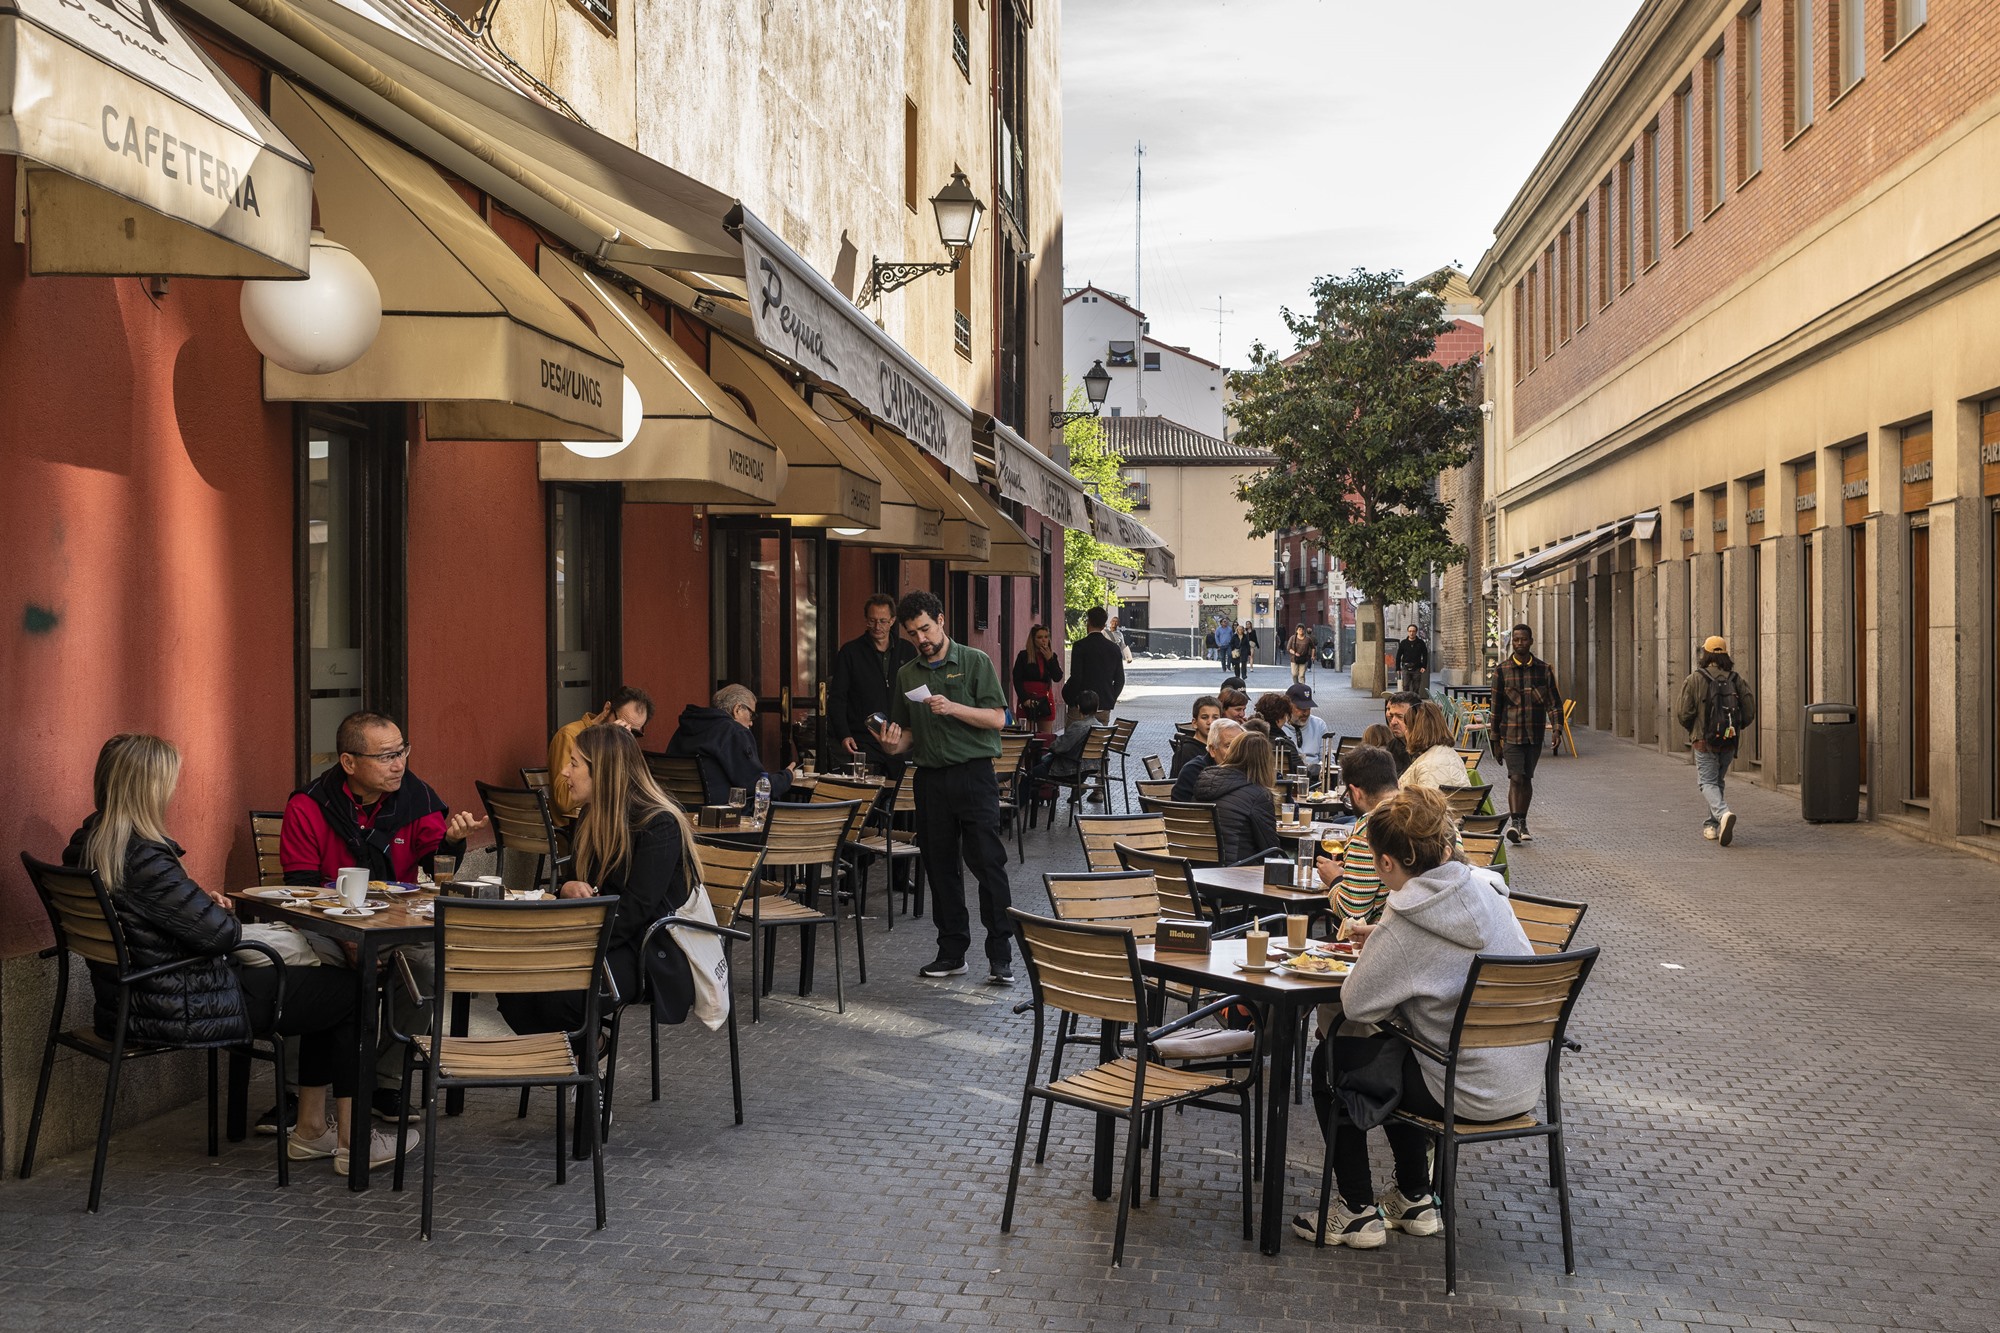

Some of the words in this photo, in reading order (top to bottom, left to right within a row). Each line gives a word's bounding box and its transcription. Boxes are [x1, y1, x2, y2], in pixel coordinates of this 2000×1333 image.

[101, 104, 261, 218] CAFETERIA
[540, 358, 603, 409] DESAYUNOS
[880, 360, 947, 459] CHURRERIA
[728, 448, 765, 483] MERIENDAS
[1981, 441, 2000, 465] FAR
[1169, 929, 1196, 939] Mahou
